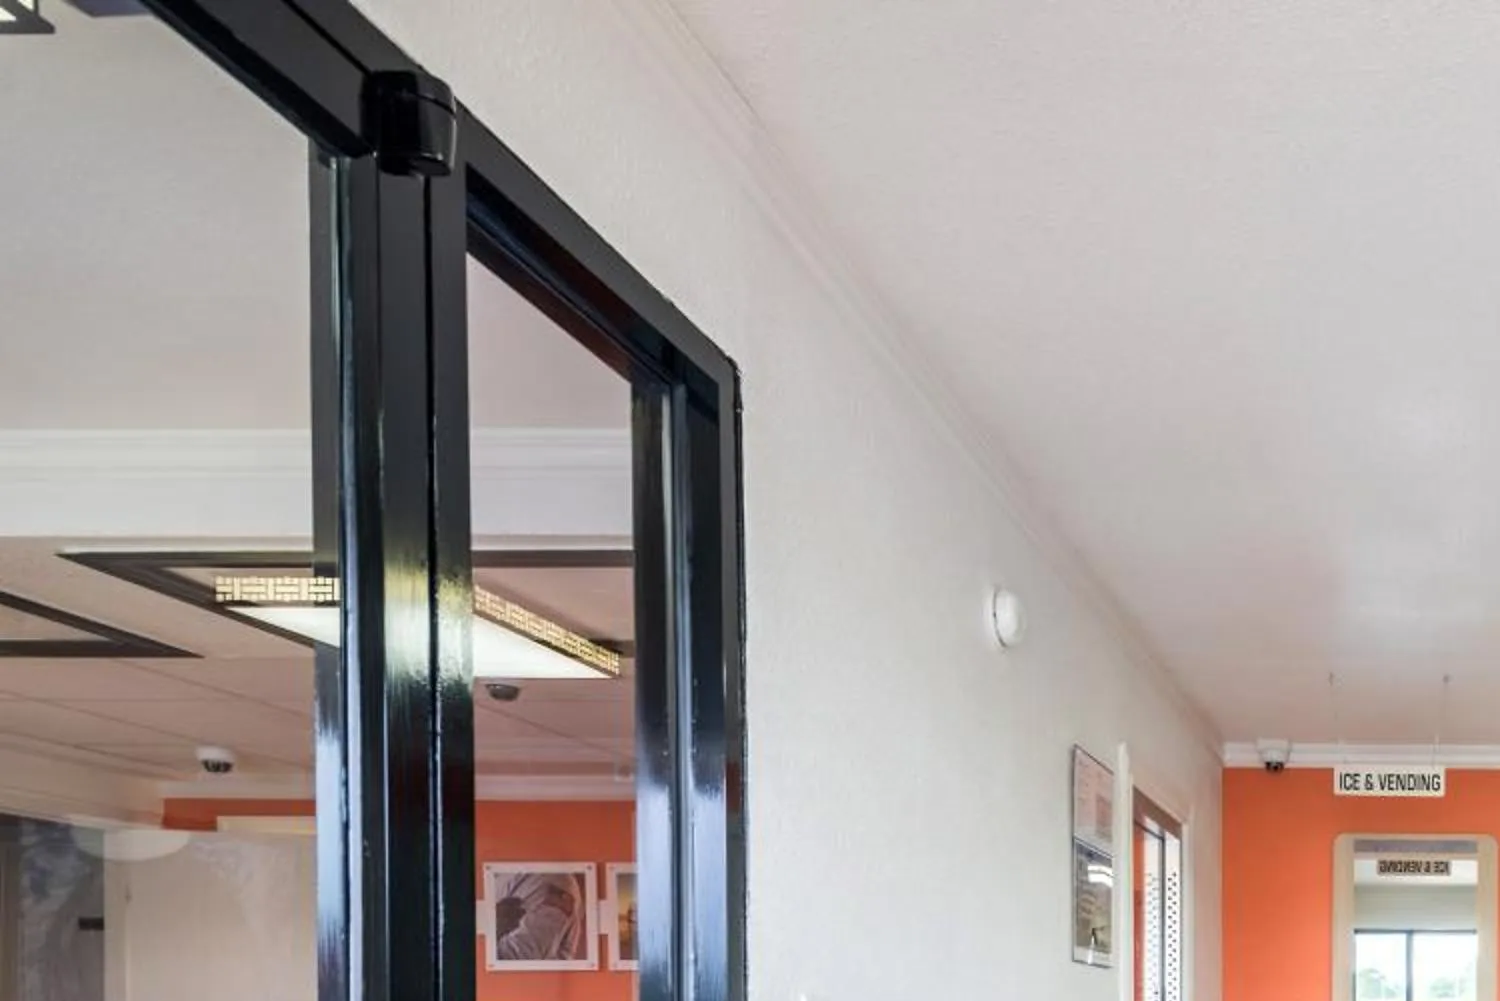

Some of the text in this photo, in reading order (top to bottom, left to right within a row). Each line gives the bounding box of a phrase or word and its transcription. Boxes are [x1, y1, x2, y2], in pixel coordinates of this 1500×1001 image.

[1339, 772, 1441, 791] ICE & VENDING
